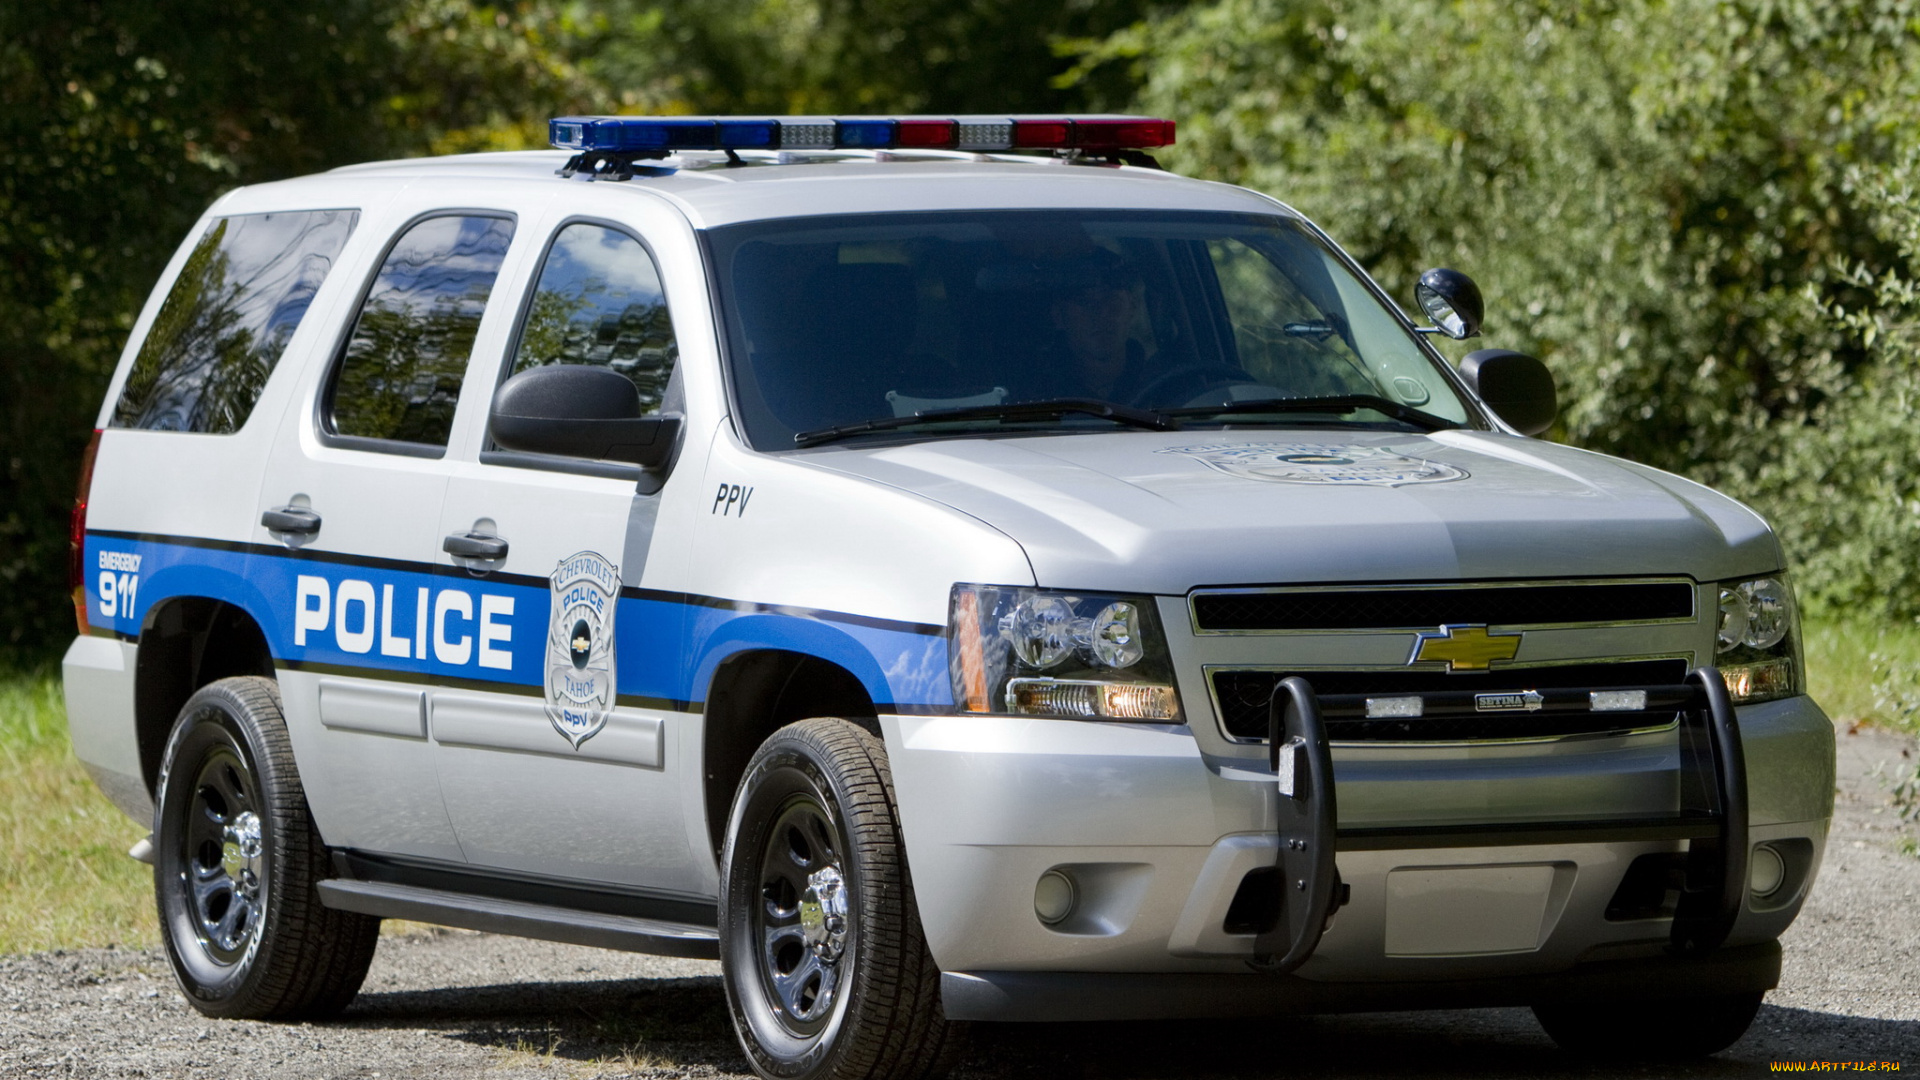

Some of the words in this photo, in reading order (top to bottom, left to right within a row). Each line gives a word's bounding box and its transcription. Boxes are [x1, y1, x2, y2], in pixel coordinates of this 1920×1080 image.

[712, 483, 754, 518] PPV
[99, 550, 142, 573] EMERGENCY
[558, 558, 613, 589] CHEVROLET
[99, 571, 139, 620] 911
[563, 588, 605, 615] POLICE
[294, 574, 515, 671] POLICE
[564, 675, 595, 698] TAHOE
[1479, 695, 1523, 706] SETINA
[564, 709, 588, 727] PPV
